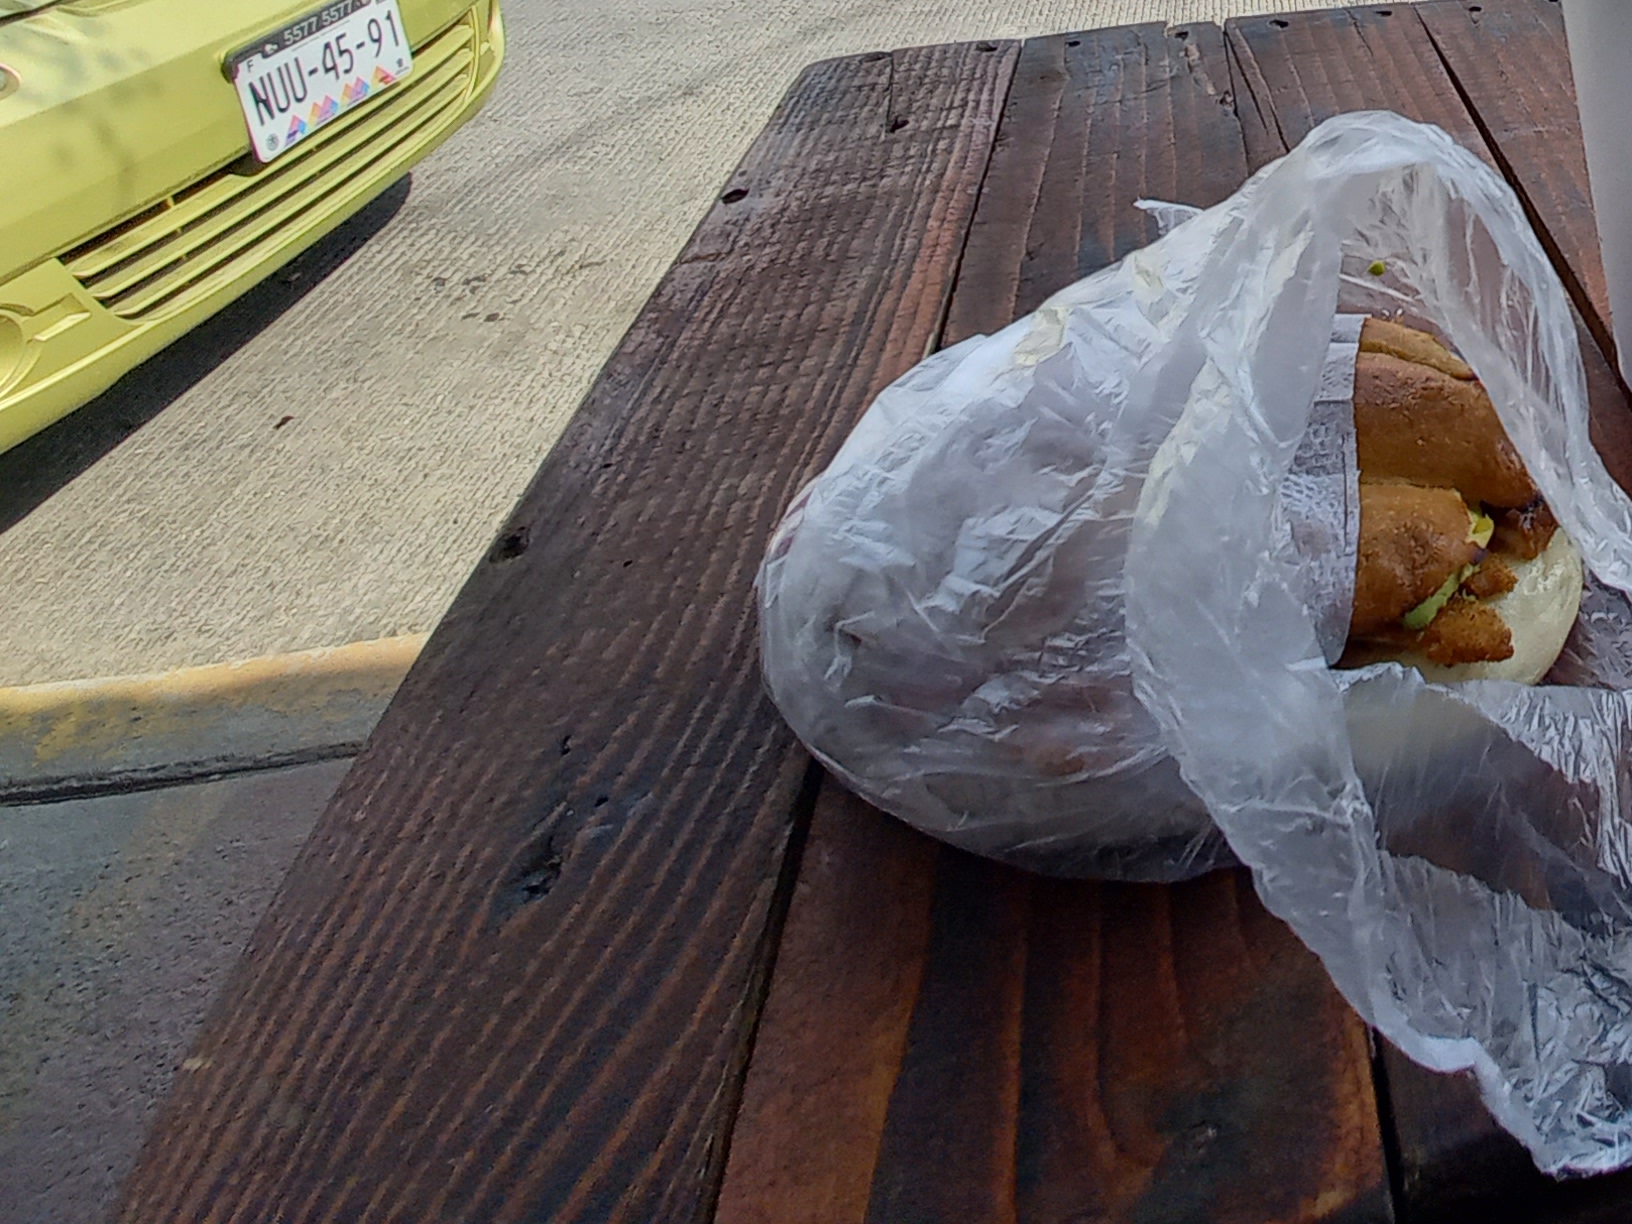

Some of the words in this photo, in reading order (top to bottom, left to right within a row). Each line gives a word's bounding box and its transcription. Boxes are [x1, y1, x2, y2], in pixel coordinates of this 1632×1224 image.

[284, 17, 317, 45] 5577
[321, 0, 353, 26] 5577
[248, 10, 399, 126] NUU-45-91
